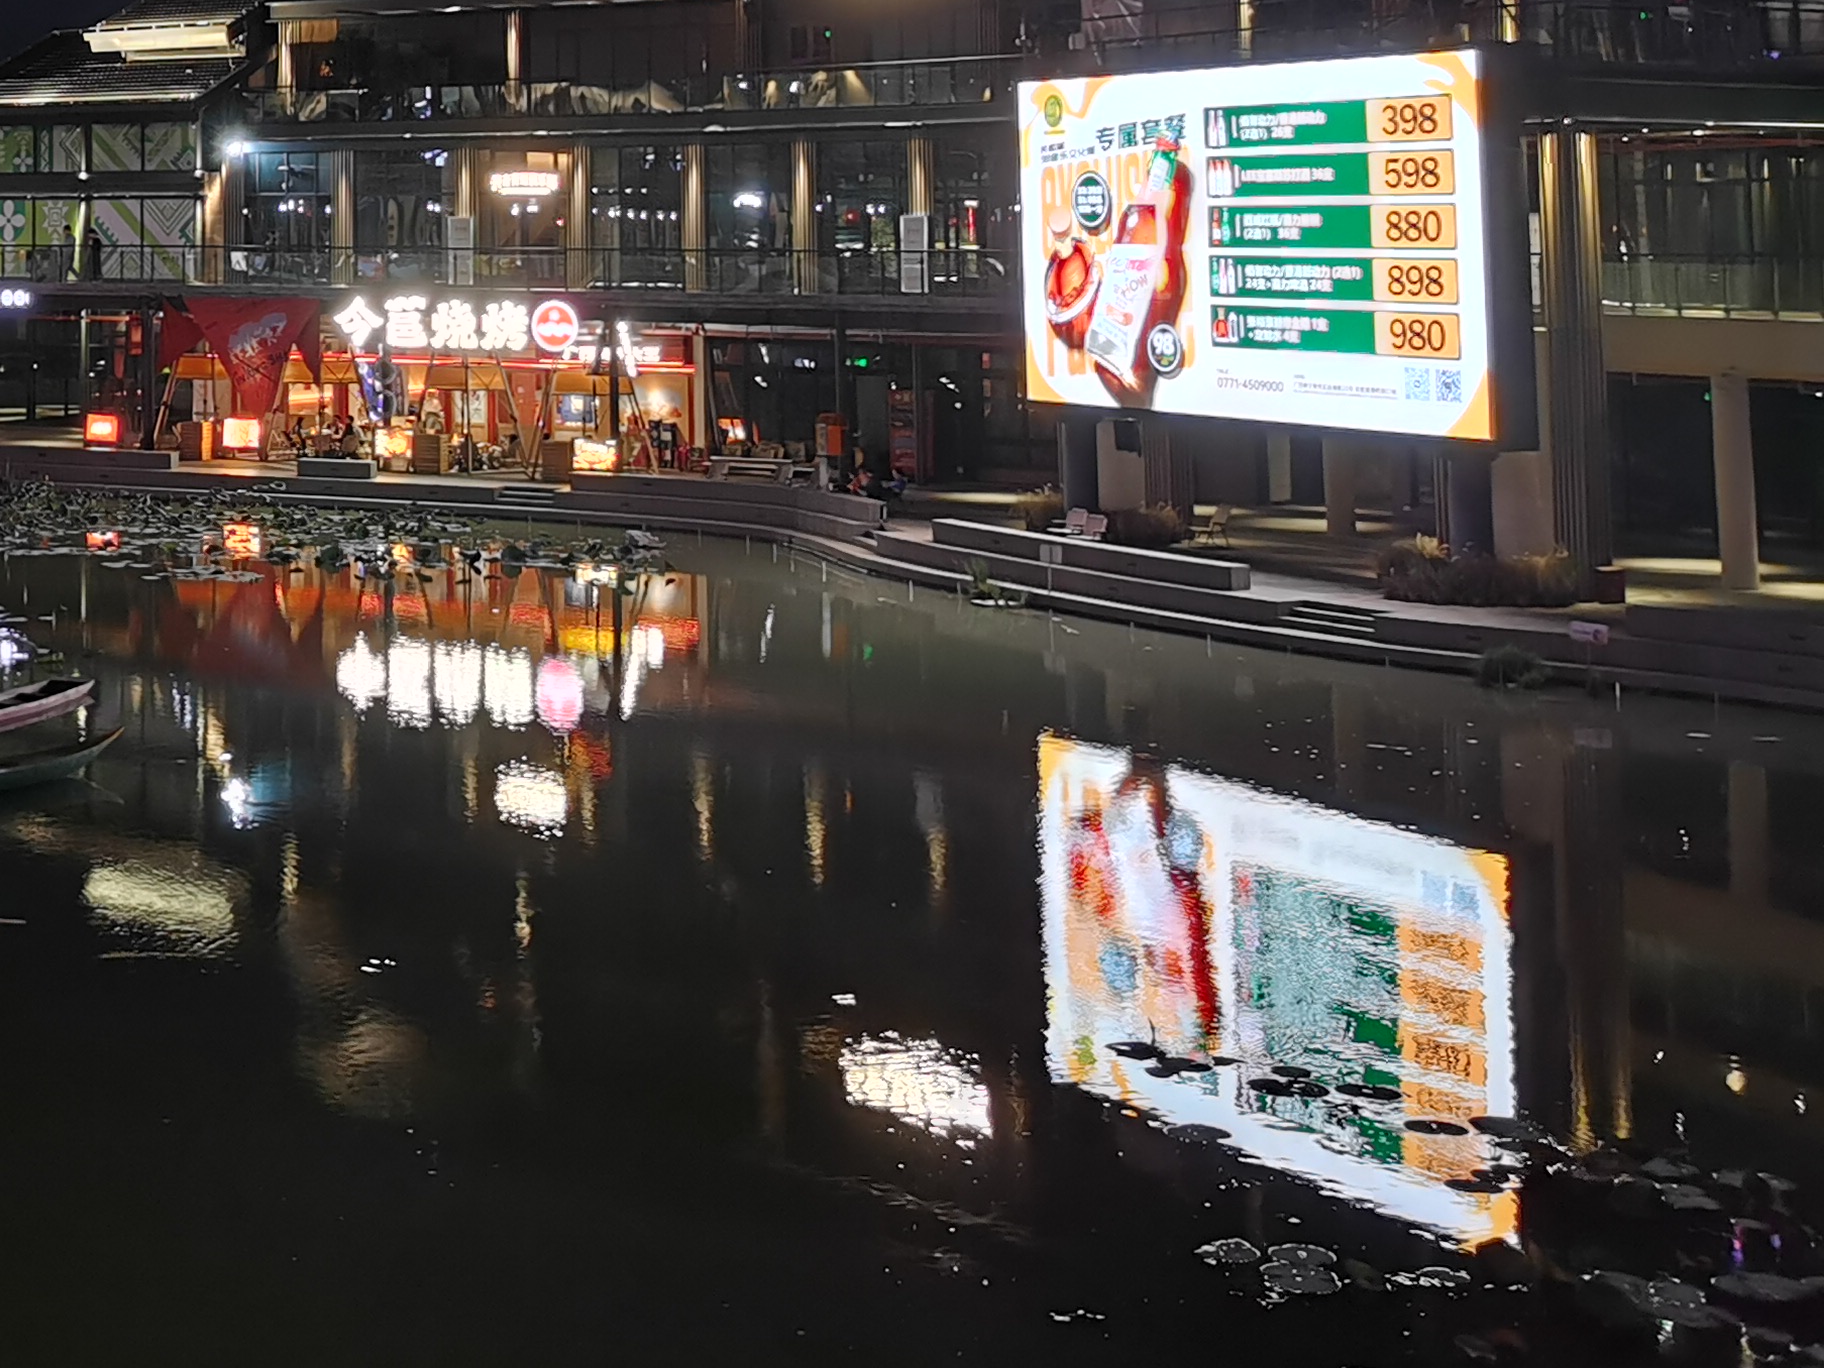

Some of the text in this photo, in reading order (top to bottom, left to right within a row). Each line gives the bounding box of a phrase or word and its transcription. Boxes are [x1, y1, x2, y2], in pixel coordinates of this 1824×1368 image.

[1382, 102, 1439, 136] 398
[1384, 156, 1441, 189] 598
[1385, 210, 1443, 242] 880
[1387, 265, 1445, 297] 898
[1153, 331, 1176, 355] 98
[1389, 318, 1447, 352] 980
[1217, 376, 1285, 393] 0771-4509000
